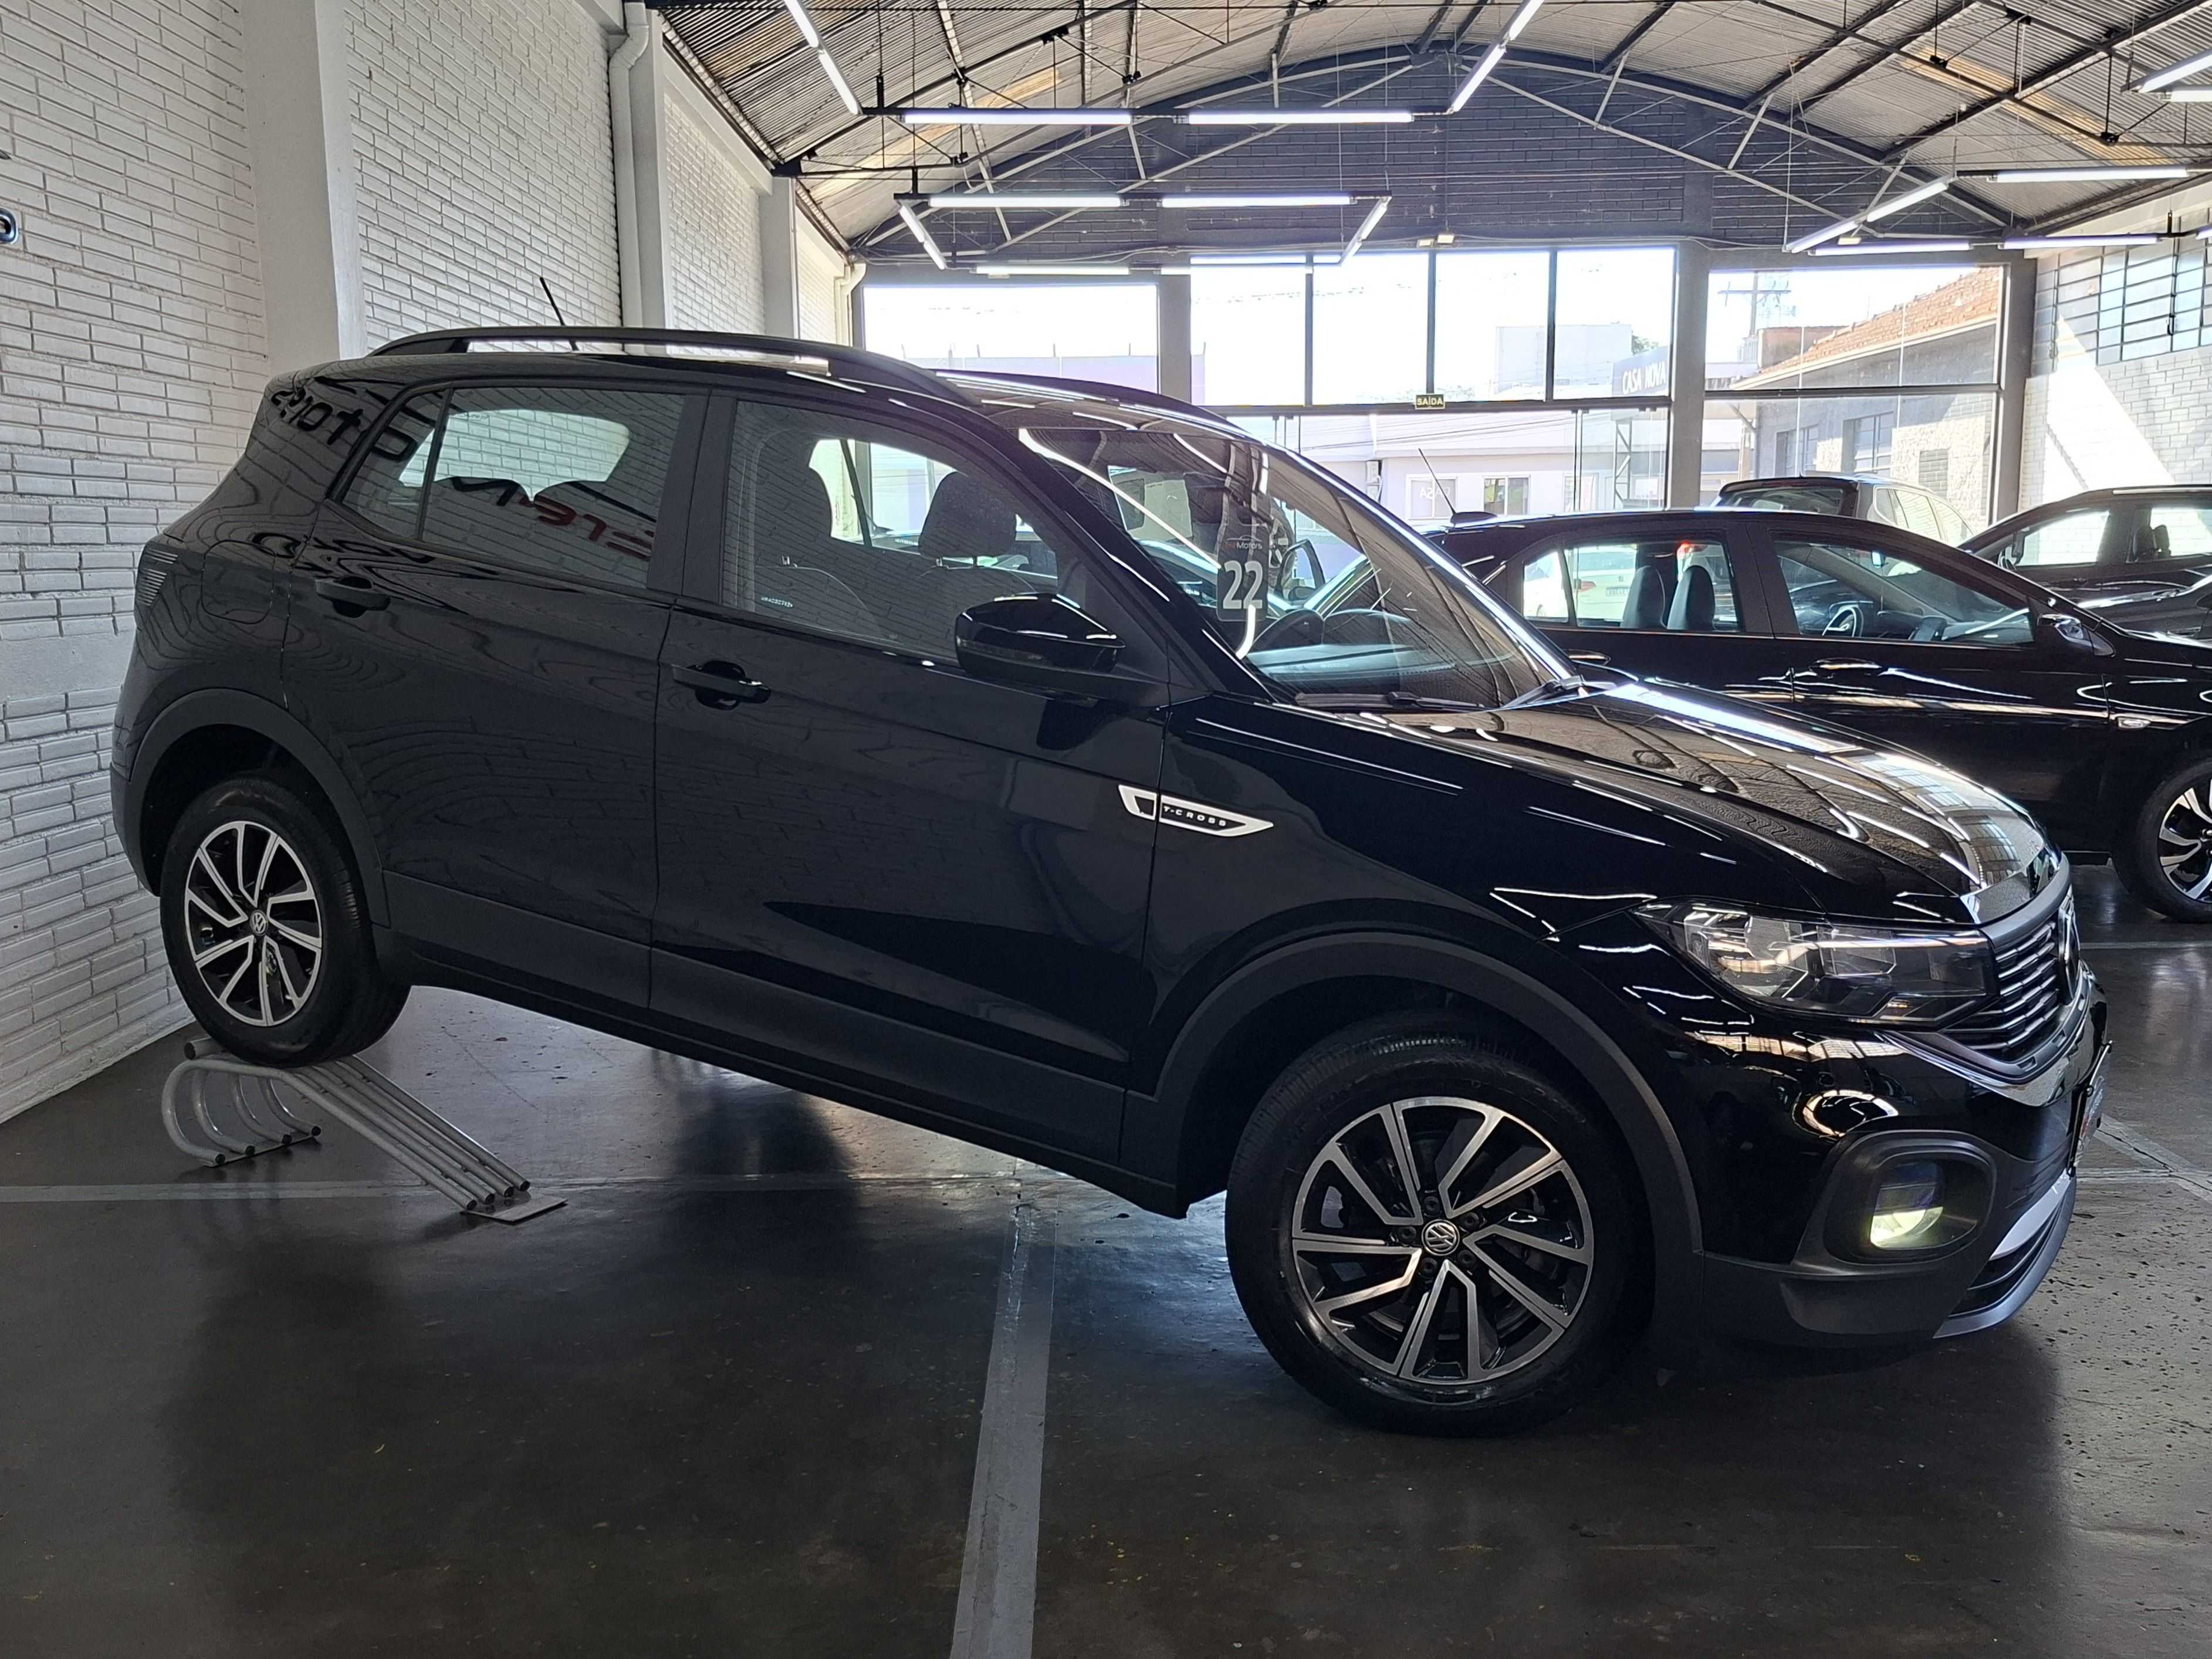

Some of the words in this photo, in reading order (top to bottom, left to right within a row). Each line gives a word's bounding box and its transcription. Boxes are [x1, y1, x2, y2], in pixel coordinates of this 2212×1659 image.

[1622, 368, 1642, 395] CASA
[1645, 361, 1666, 388] NOVA
[1223, 560, 1263, 610] 22
[1164, 805, 1226, 827] T-CROSS
